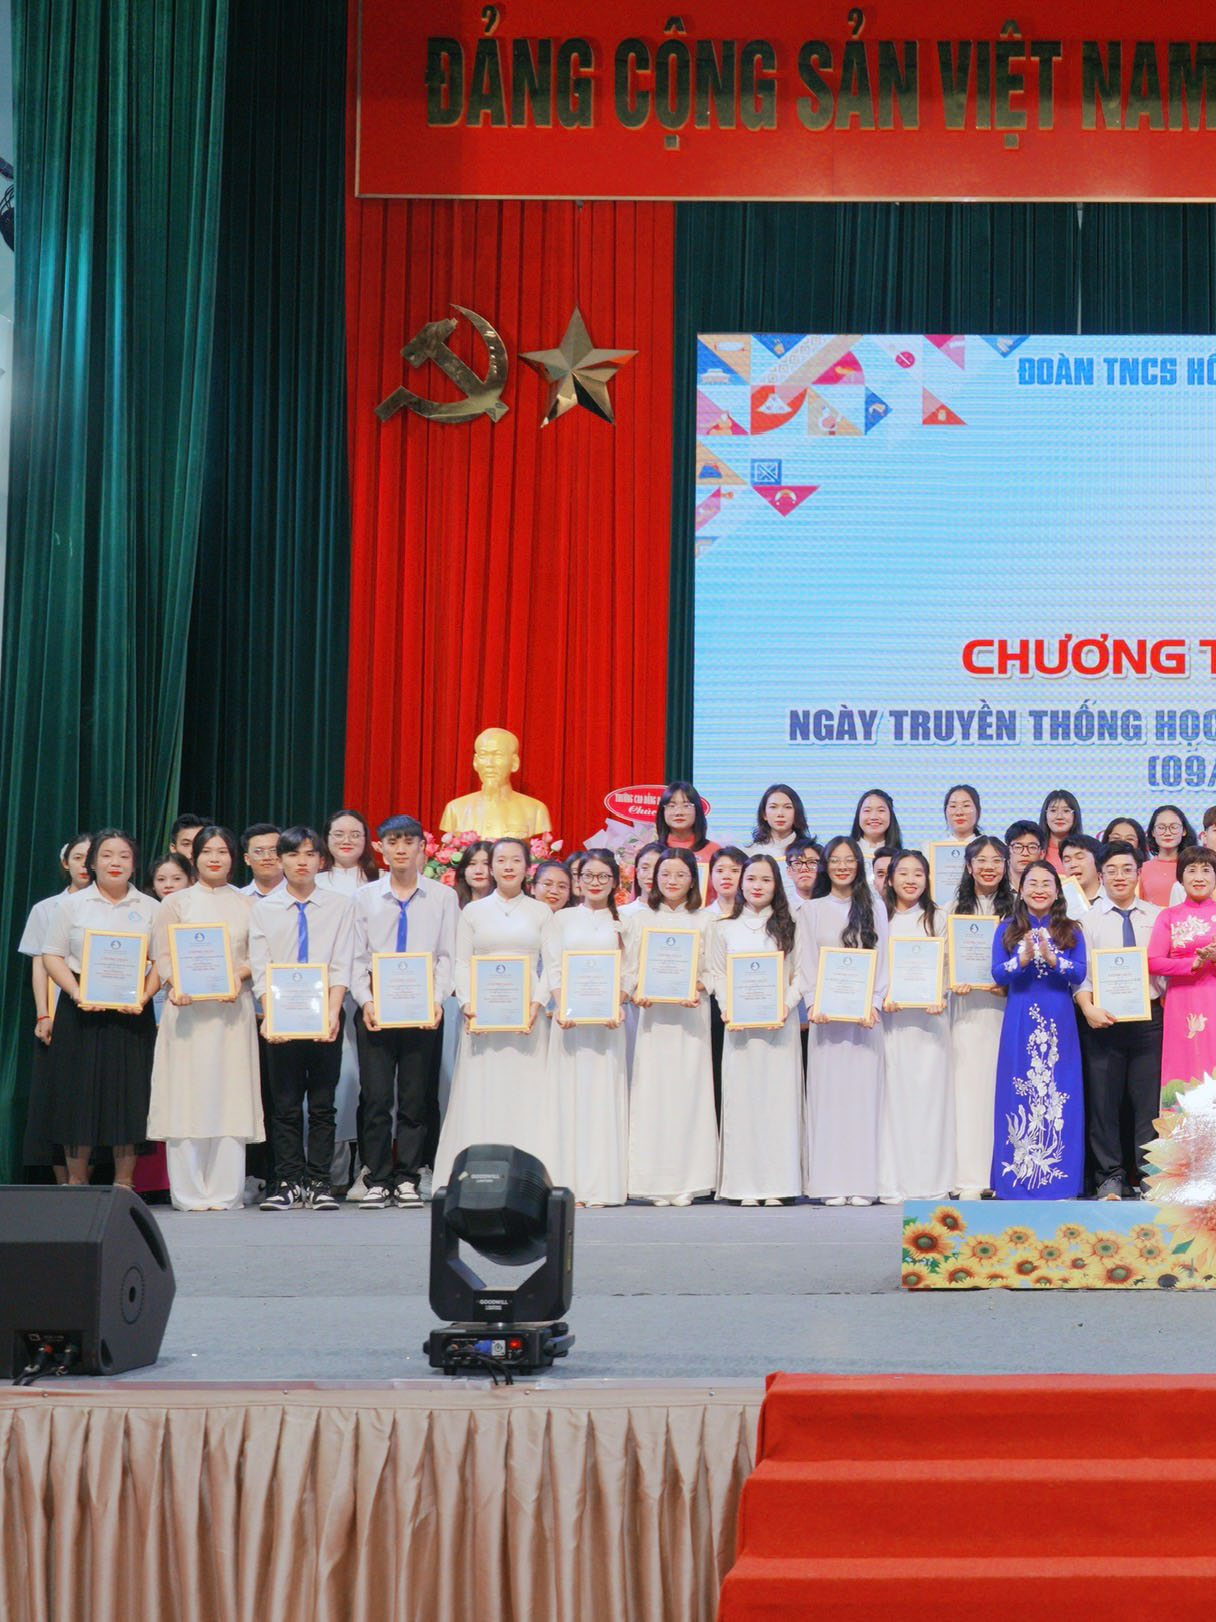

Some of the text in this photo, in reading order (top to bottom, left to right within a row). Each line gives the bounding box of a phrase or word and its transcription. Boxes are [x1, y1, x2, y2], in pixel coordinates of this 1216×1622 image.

[424, 5, 595, 129] ĐẢNG
[615, 16, 779, 151] CỘNG
[797, 8, 919, 132] SẢN
[937, 19, 1063, 149] VIỆT
[1017, 353, 1094, 386] ĐOÀN
[1104, 356, 1178, 386] TNCS
[961, 633, 1187, 676] CHƯƠNG
[789, 704, 879, 742] NGÀY
[888, 699, 1017, 742] TRUYỀN
[1028, 699, 1143, 742] THỐNG
